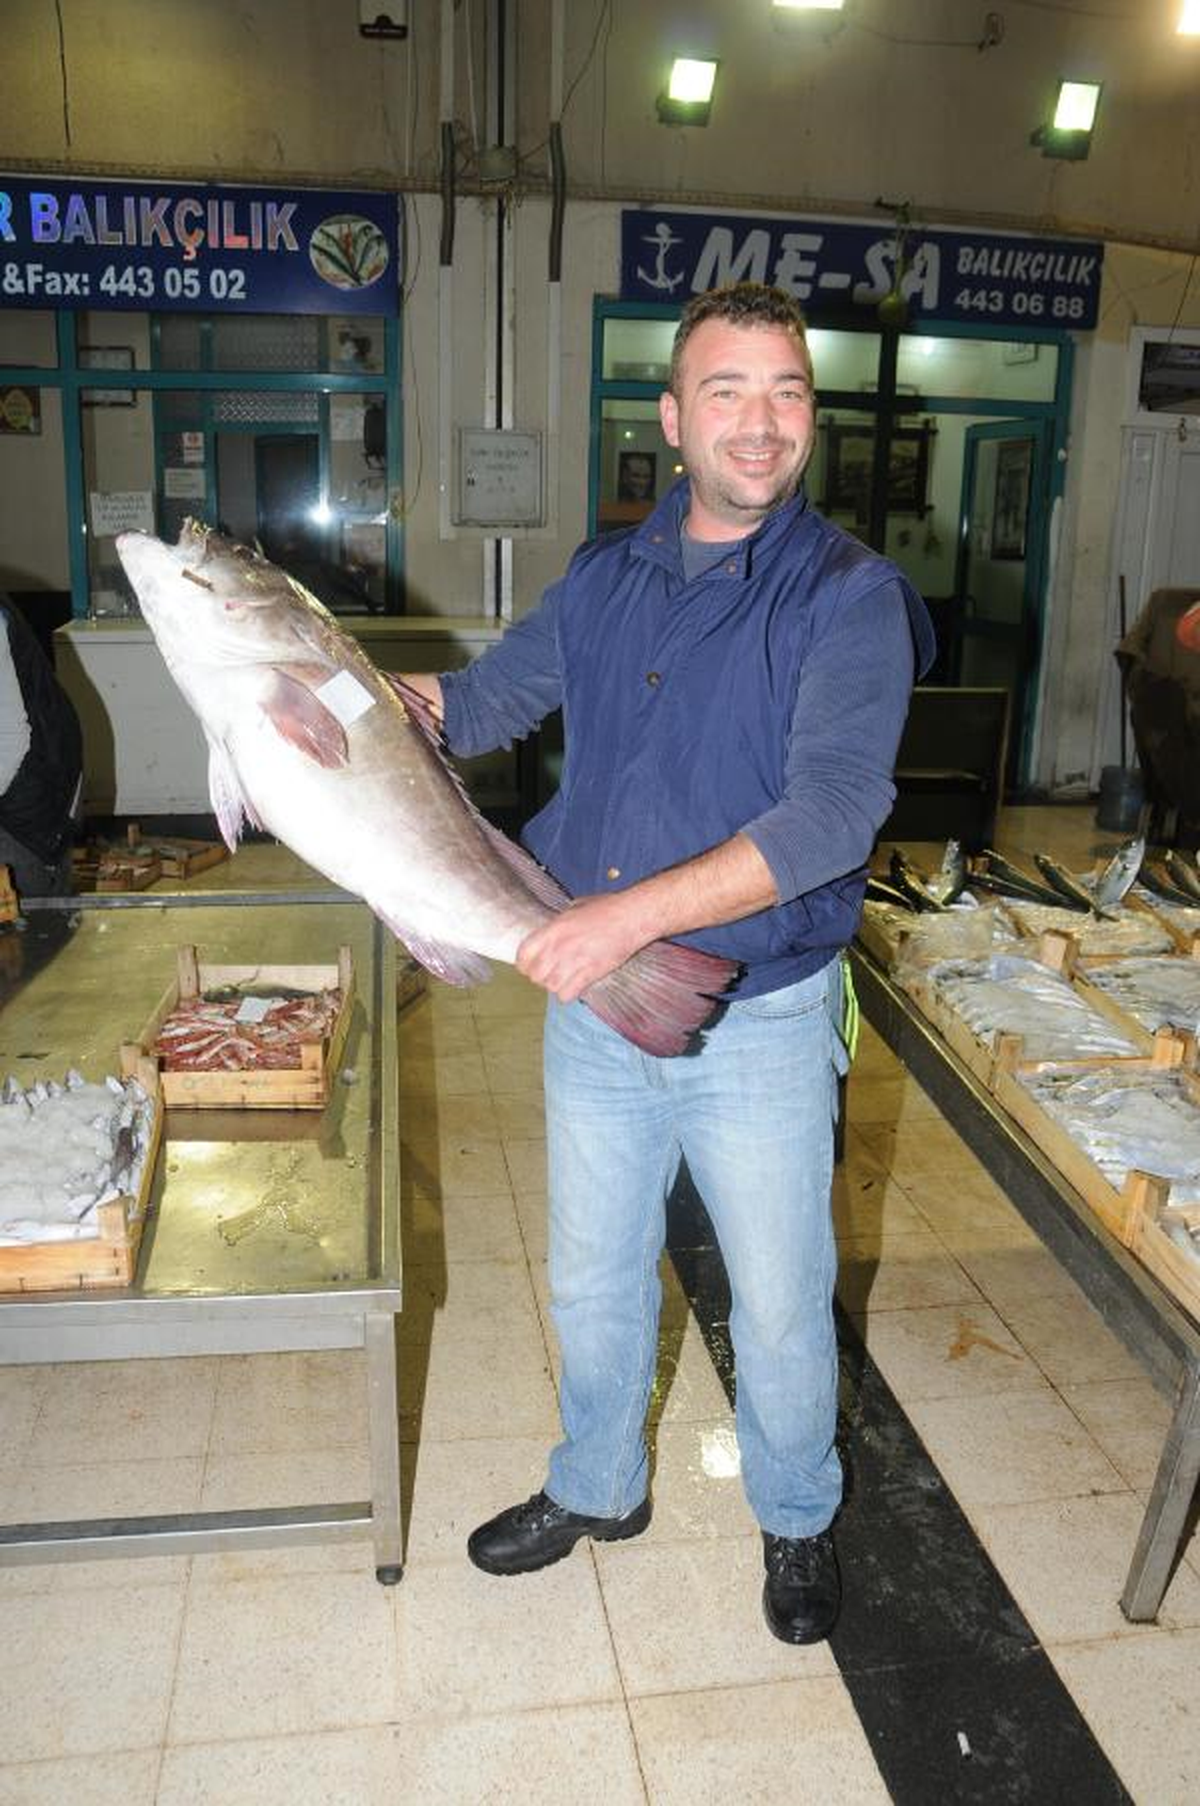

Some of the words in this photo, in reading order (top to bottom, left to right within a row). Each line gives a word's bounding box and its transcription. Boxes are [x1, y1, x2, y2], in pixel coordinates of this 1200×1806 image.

[29, 192, 299, 260] BALIKÇILIK
[2, 262, 90, 295] &Fax:
[100, 264, 155, 297] 443
[164, 267, 201, 298] 05
[209, 268, 247, 299] 02
[690, 226, 940, 310] ME-SA
[957, 247, 1096, 285] BALIKÇILIK
[955, 288, 1004, 312] 443
[1012, 292, 1044, 315] 06
[1053, 295, 1084, 318] 88
